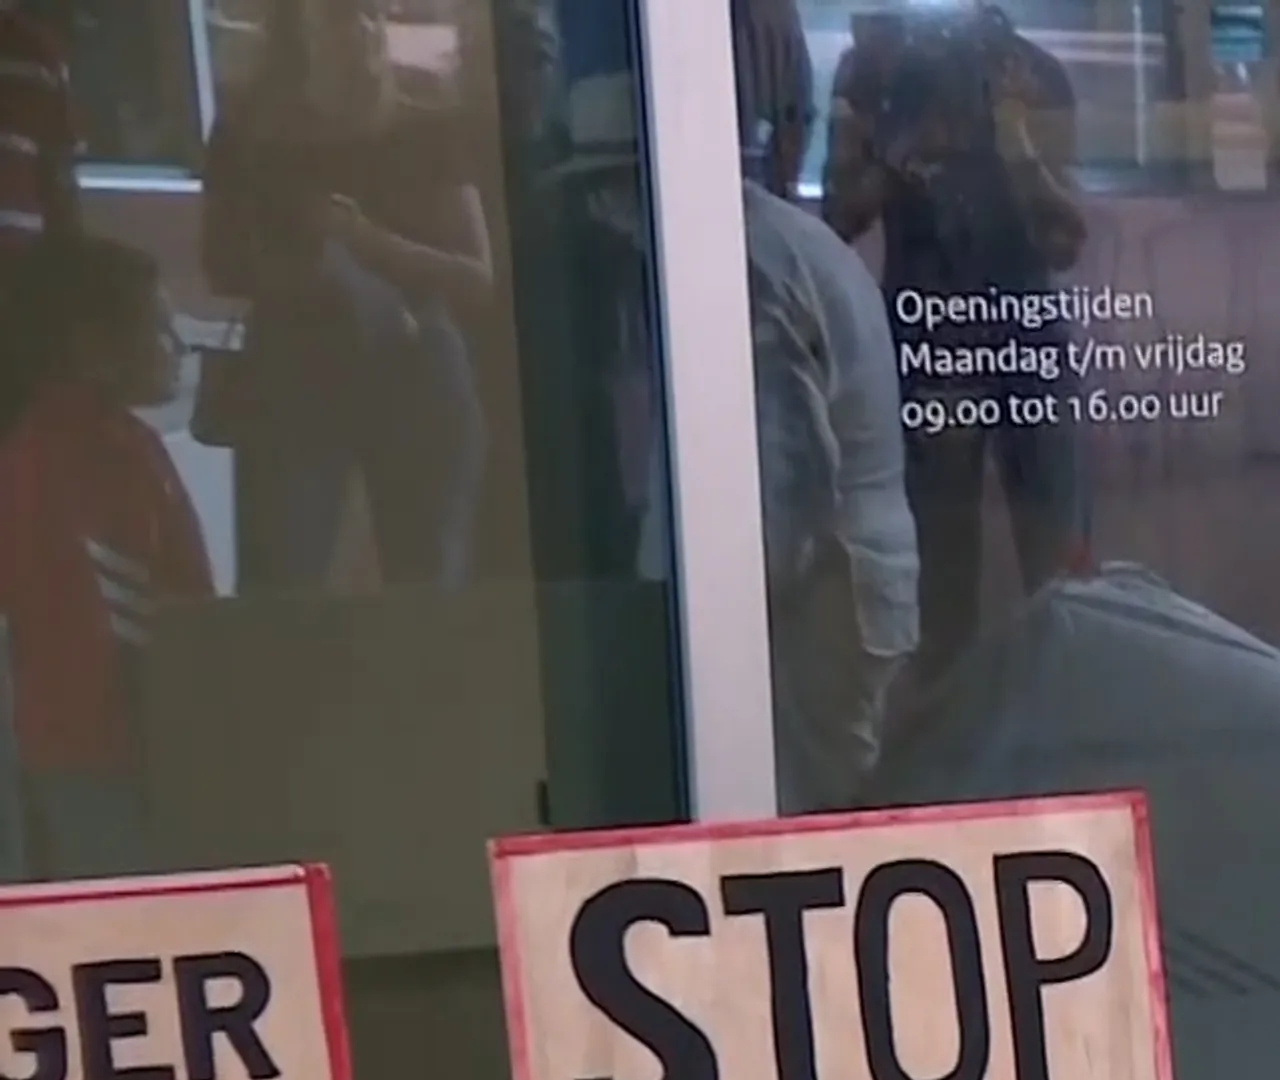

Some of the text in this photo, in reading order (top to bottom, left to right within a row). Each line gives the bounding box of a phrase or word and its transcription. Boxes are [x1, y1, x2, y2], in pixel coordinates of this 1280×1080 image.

[895, 287, 1154, 331] Openingstijden
[900, 333, 1246, 380] Maandag t/m vrijdag
[902, 388, 1224, 433] 09.00 tot 16.00 uur
